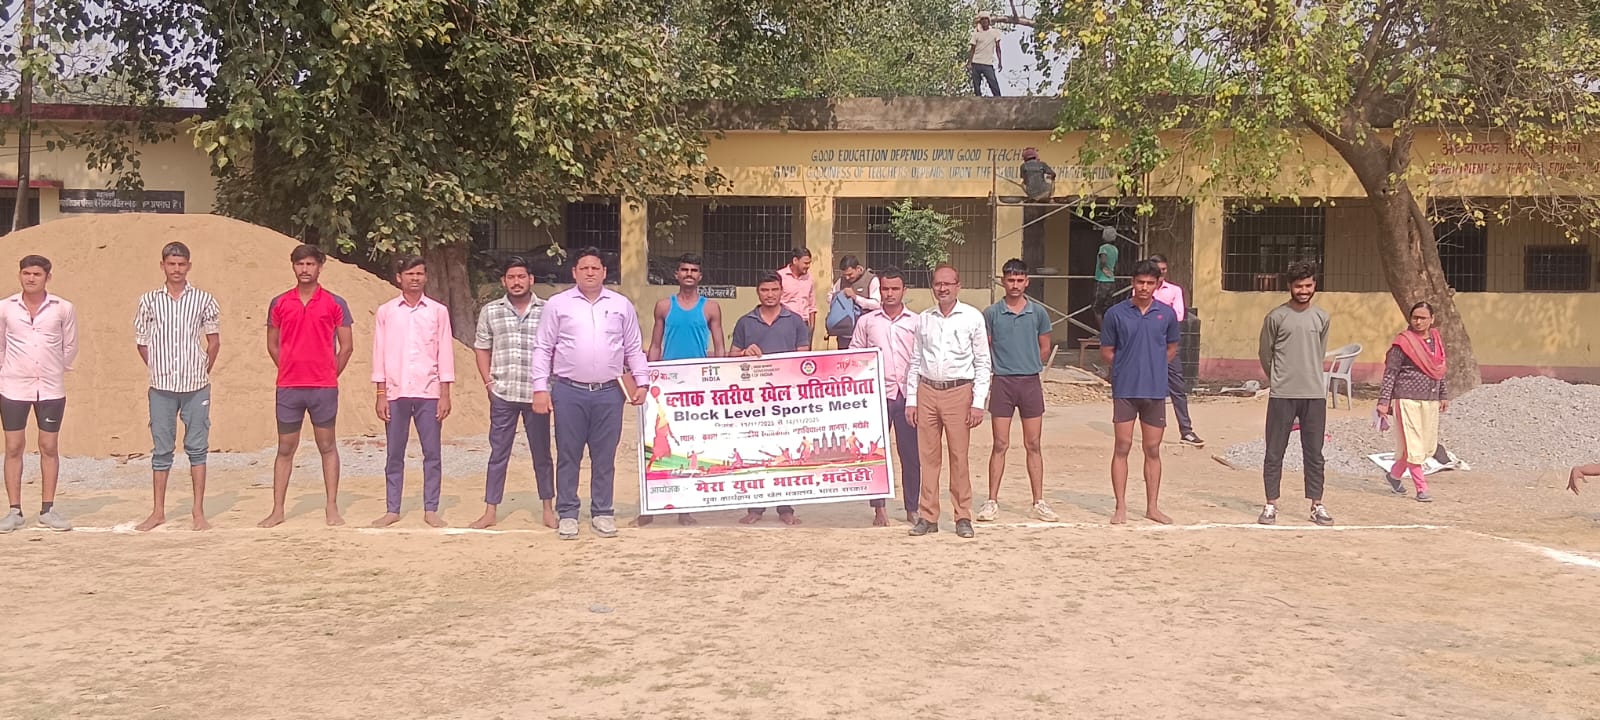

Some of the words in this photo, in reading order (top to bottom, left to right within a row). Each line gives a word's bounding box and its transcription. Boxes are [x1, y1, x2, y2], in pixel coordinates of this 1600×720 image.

[811, 149, 834, 162] GOOD
[838, 149, 887, 162] EDUCATION
[890, 149, 928, 162] DEPENDS
[932, 149, 954, 161] UPON
[957, 149, 981, 162] GOOD
[773, 165, 797, 178] AND
[949, 165, 971, 178] UPON
[710, 384, 755, 405] स्तरीय
[759, 382, 792, 402] खेल
[796, 376, 874, 400] प्रतियोगिता
[674, 409, 719, 421] Block
[725, 406, 766, 419] Level
[772, 403, 823, 417] Sports
[829, 398, 868, 411] Meet
[694, 480, 725, 493] मेरा
[732, 478, 766, 494] युवा
